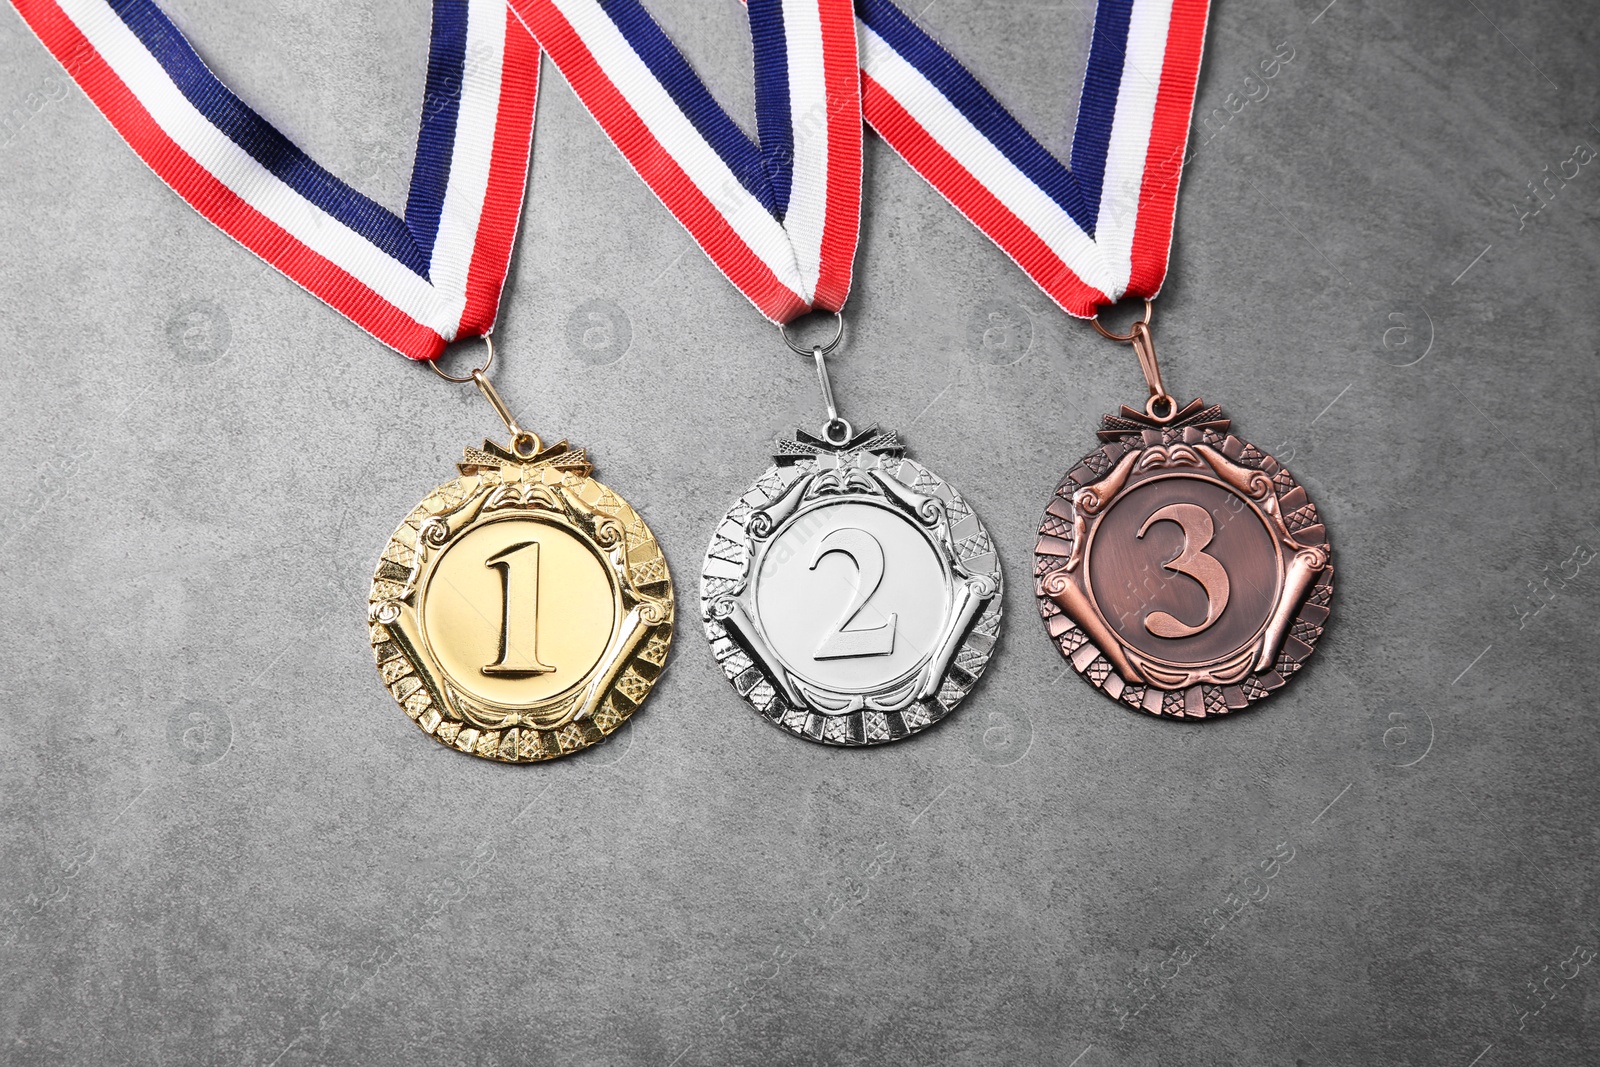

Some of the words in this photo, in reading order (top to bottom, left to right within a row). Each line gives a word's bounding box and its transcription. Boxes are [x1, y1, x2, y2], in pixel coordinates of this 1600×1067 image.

[481, 541, 557, 679] 1
[808, 527, 898, 661] 2
[1135, 503, 1230, 638] 3
